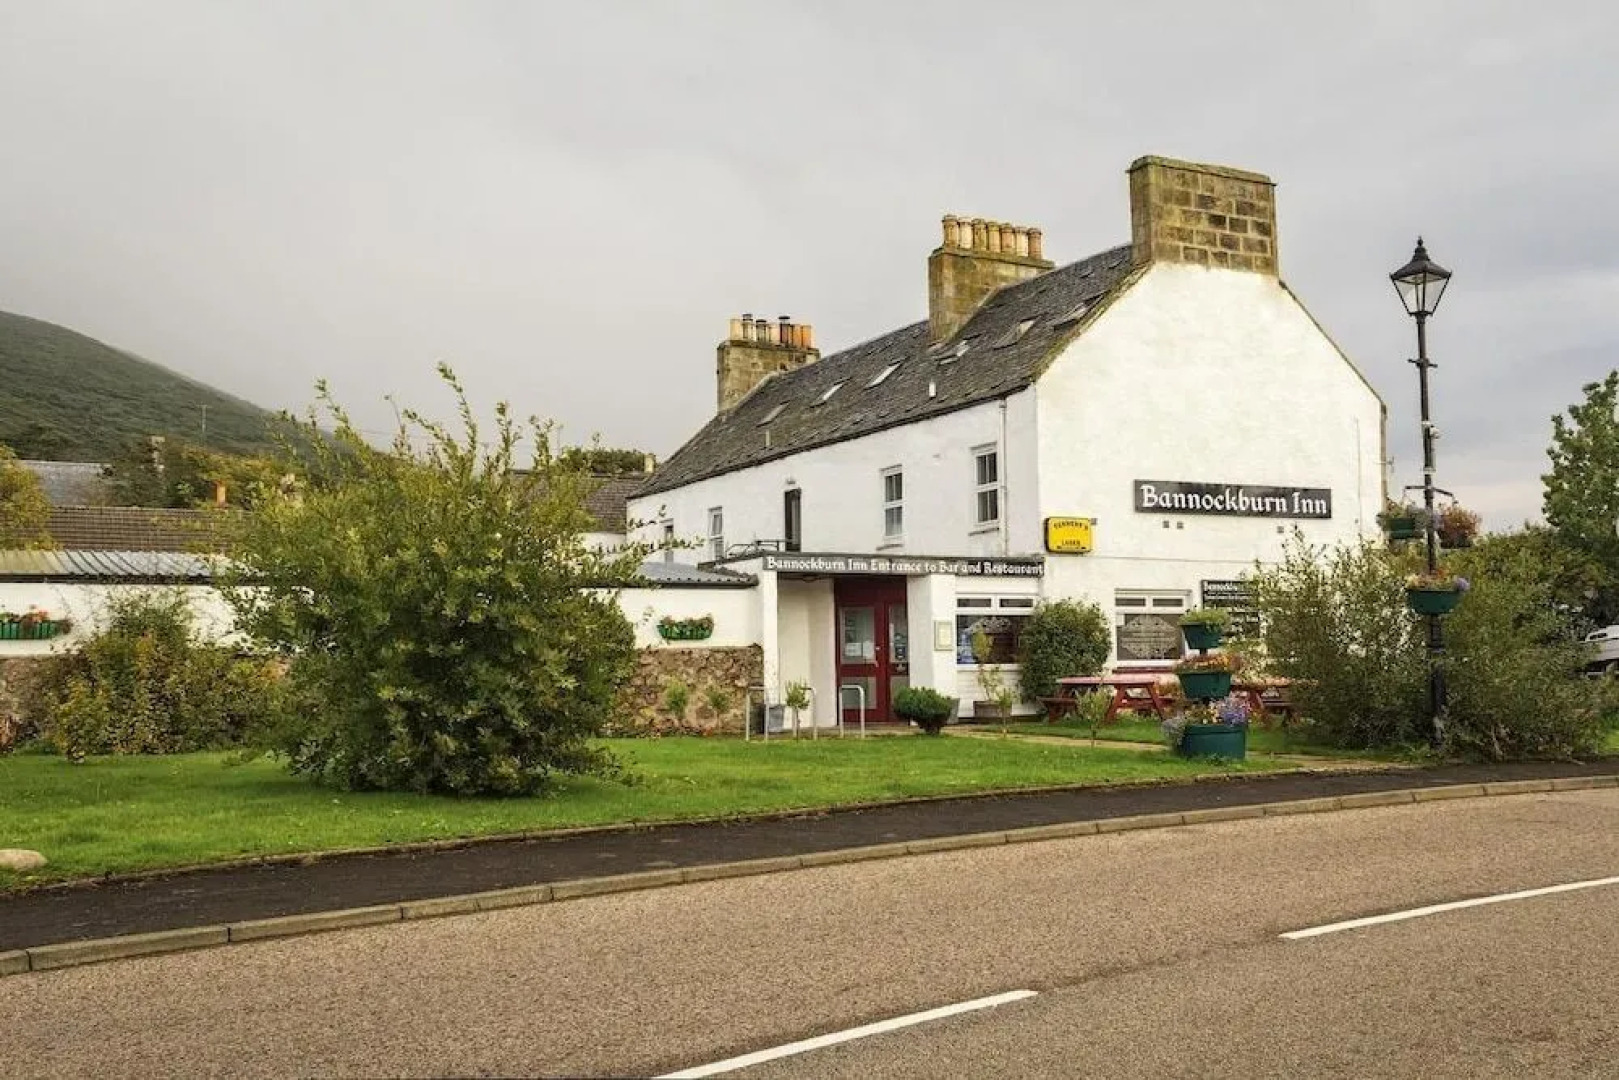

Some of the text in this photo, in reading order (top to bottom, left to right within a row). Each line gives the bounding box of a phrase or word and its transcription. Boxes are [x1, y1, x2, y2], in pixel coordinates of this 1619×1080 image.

[1140, 484, 1327, 514] Bannockburn Inn
[766, 556, 1043, 575] Bannockburn Inn Entrance to Bar and Restaurant
